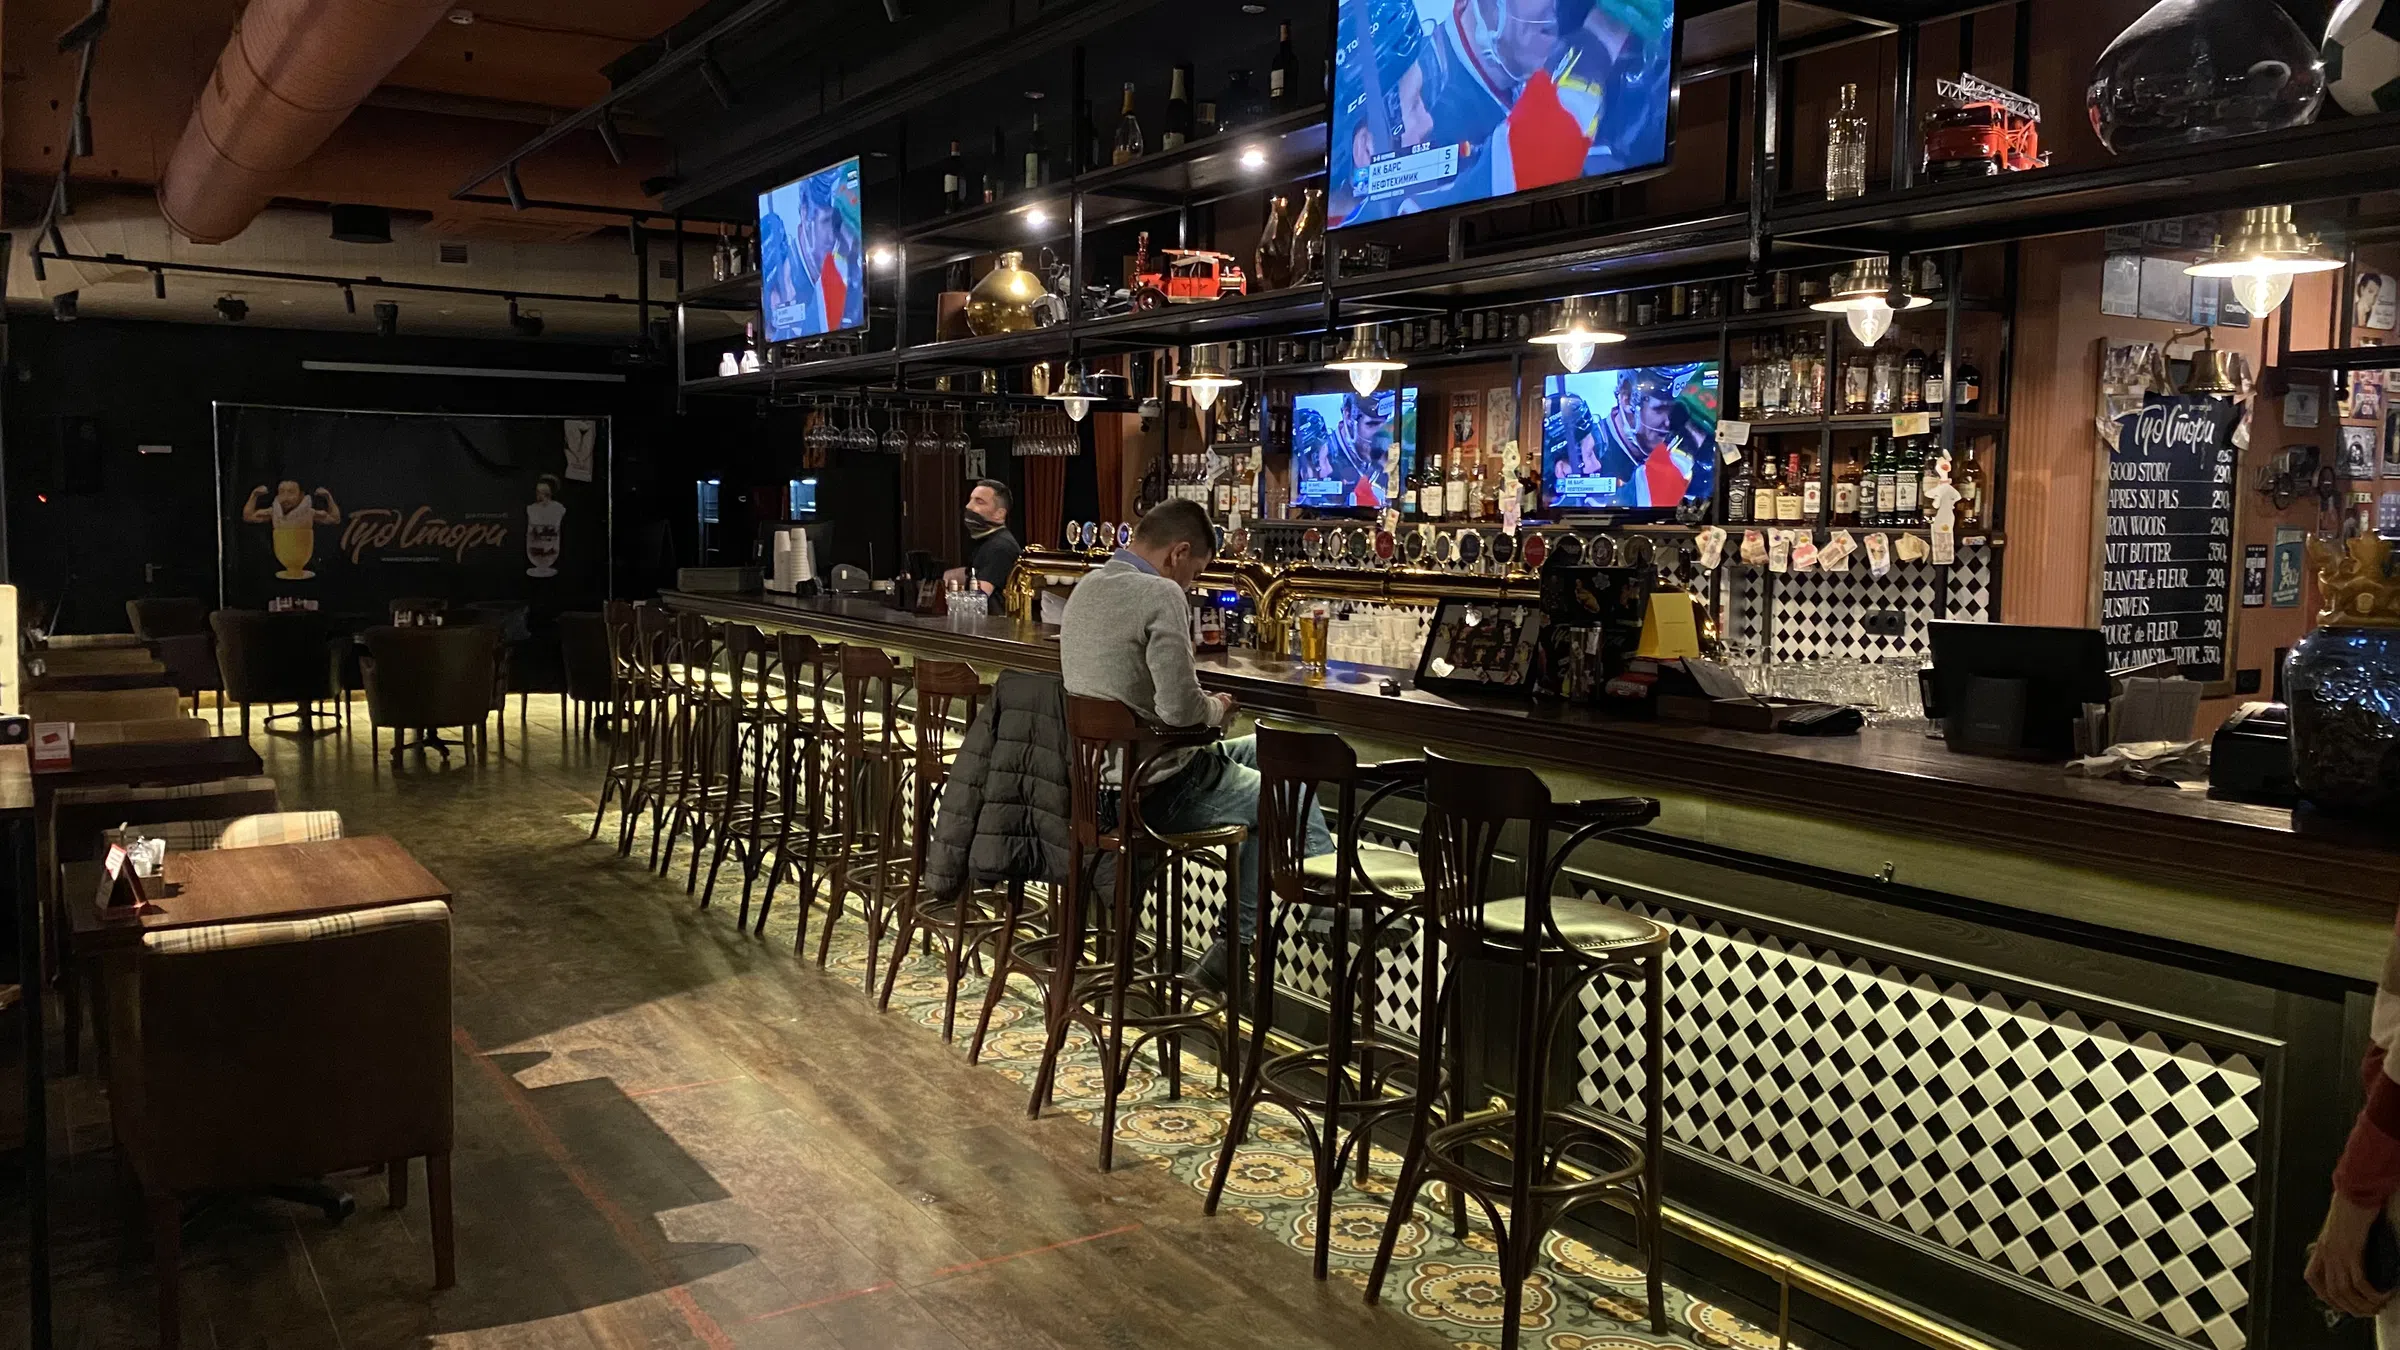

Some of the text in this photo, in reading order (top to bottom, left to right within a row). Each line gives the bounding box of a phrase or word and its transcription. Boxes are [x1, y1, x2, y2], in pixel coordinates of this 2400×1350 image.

[1372, 149, 1451, 176] АК БАРС 5
[1371, 164, 1450, 191] НЕФТЕХИМИК 2
[2109, 462, 2137, 481] GOOD
[2138, 462, 2171, 482] STORY
[2107, 489, 2137, 509] APRES
[2139, 489, 2157, 509] SKI
[2158, 489, 2179, 509] PILS
[2130, 516, 2166, 536] WOODS
[2105, 543, 2128, 564] NUT
[2129, 542, 2171, 563] BUTTER
[2103, 569, 2147, 591] BLANCHE
[2157, 568, 2188, 589] FLEUR
[2103, 596, 2149, 618] AUSWEIS
[2134, 626, 2144, 643] de
[2147, 621, 2179, 642] FLEUR
[2171, 646, 2200, 665] TROPIC
